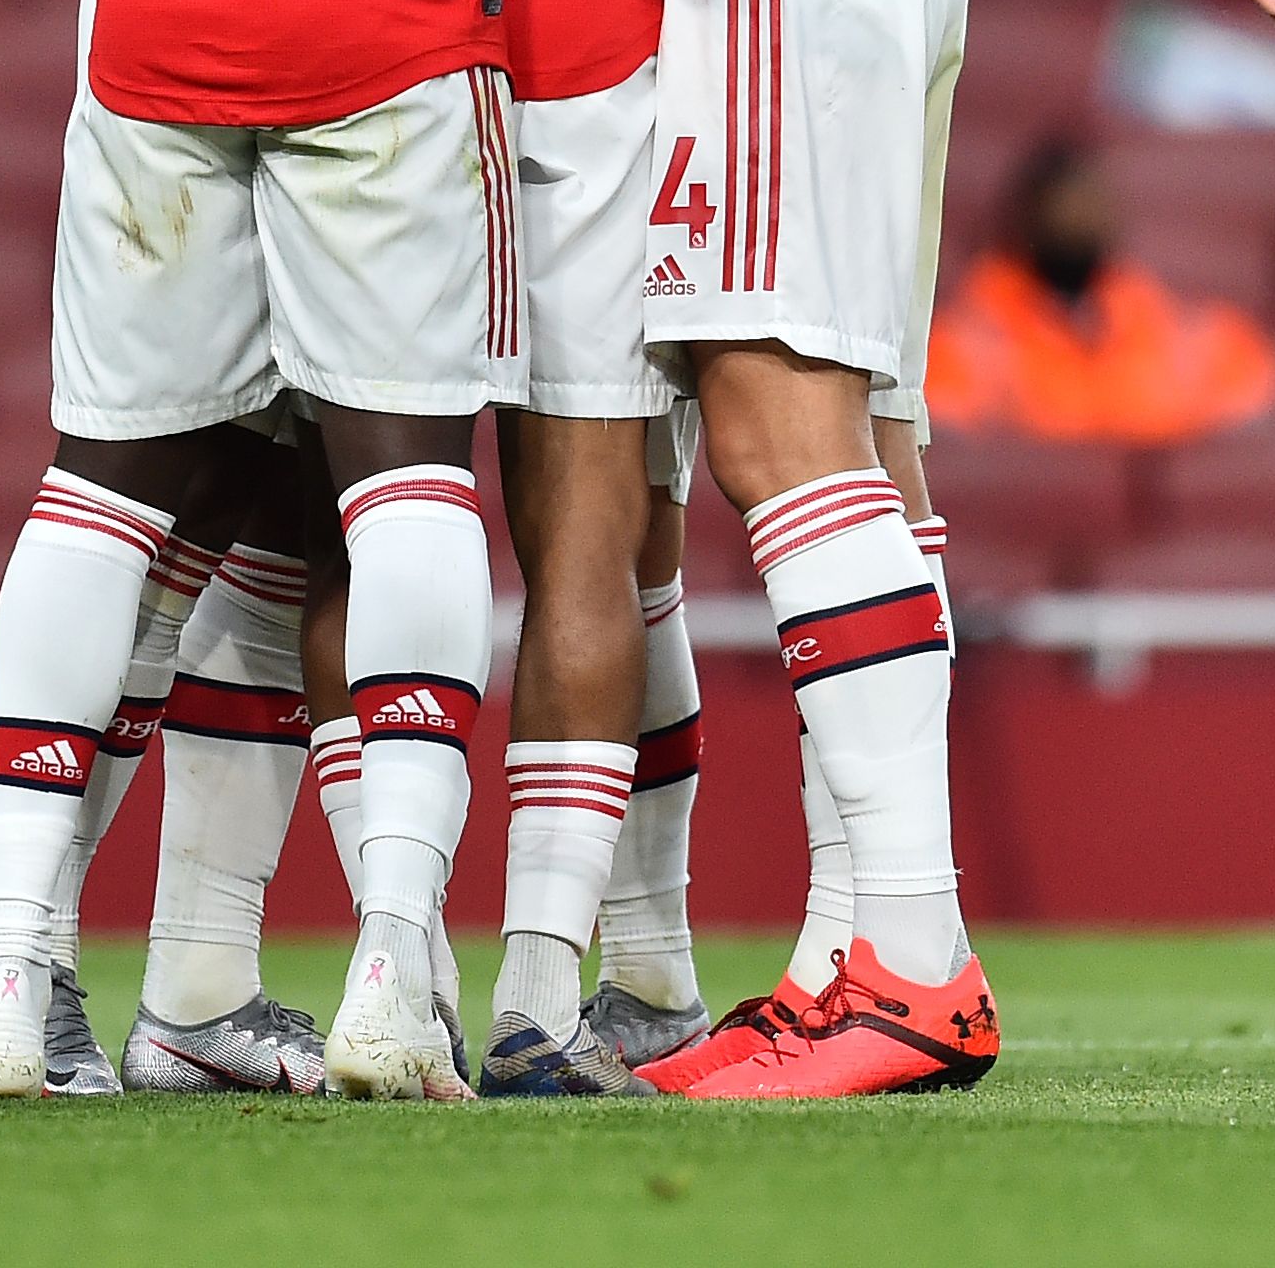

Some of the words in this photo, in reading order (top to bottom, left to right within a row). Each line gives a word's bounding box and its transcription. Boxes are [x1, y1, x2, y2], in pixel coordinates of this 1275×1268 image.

[649, 136, 718, 249] 4
[372, 710, 456, 730] adidas
[10, 758, 84, 780] adidas
